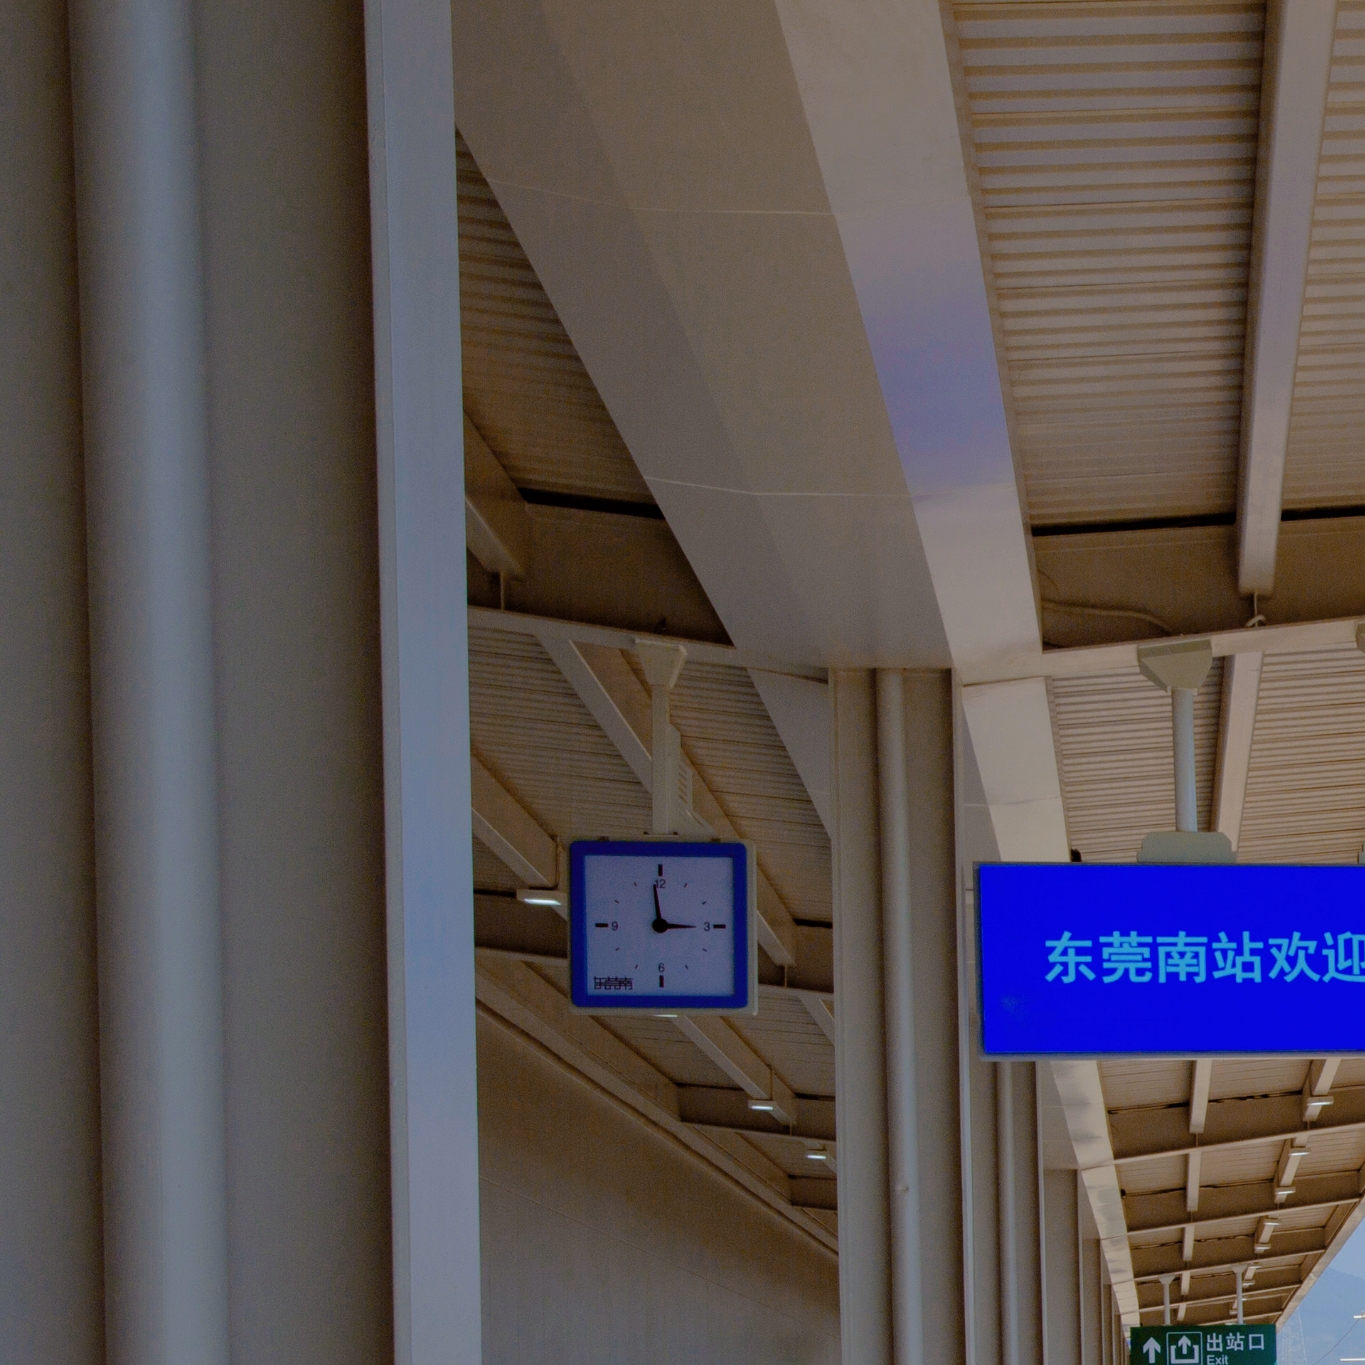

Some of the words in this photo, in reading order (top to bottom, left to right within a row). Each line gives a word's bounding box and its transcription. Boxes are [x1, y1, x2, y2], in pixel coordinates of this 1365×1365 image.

[611, 921, 619, 932] 9
[703, 922, 711, 932] 3
[658, 962, 666, 973] 6
[1206, 1332, 1265, 1352] 出站口
[1206, 1354, 1229, 1365] Exit
